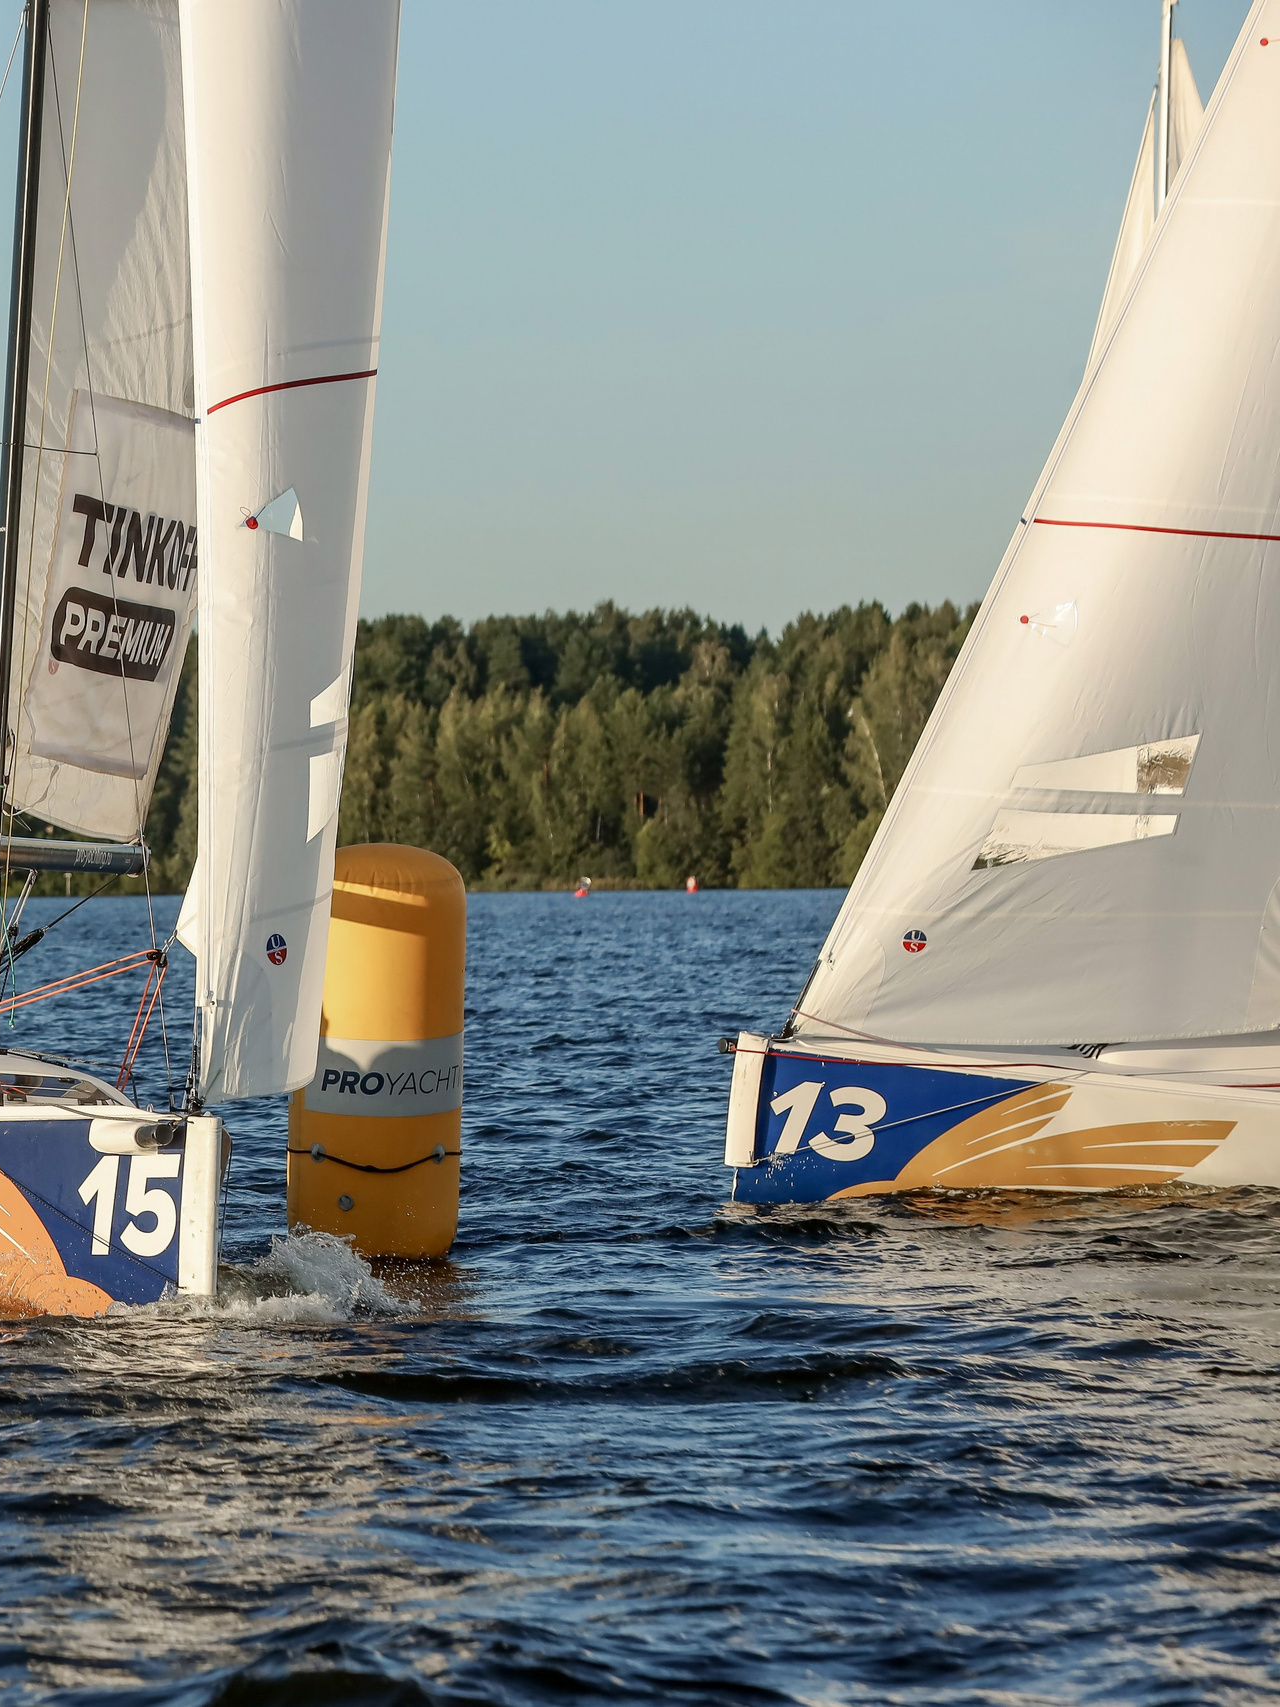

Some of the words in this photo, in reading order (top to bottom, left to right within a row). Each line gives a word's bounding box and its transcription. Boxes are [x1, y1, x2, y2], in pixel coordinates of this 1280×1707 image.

[59, 601, 171, 667] PREMIUM
[769, 1081, 888, 1162] 13
[77, 1153, 182, 1257] 15
